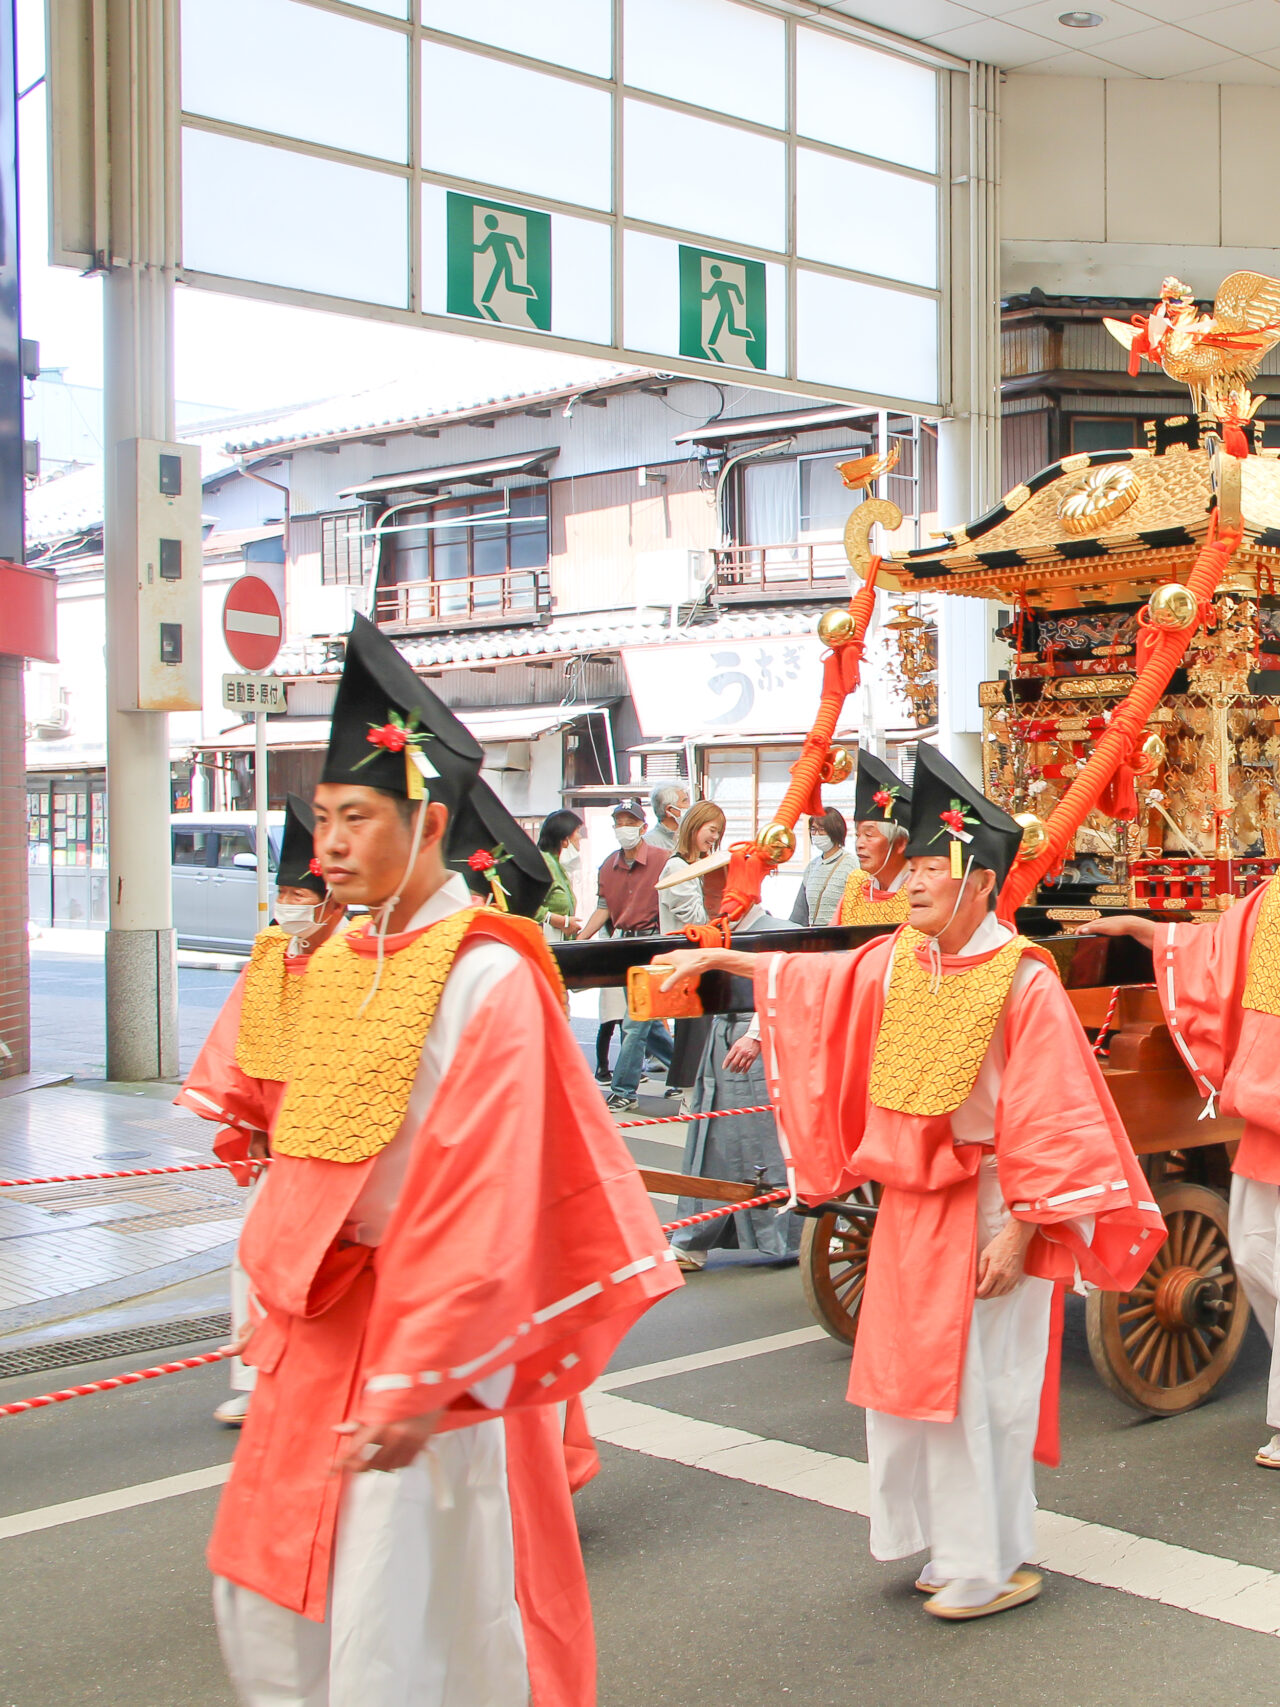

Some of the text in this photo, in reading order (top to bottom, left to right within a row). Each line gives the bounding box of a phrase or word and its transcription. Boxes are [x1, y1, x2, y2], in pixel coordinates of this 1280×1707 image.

[227, 681, 278, 705] 自動車・原付
